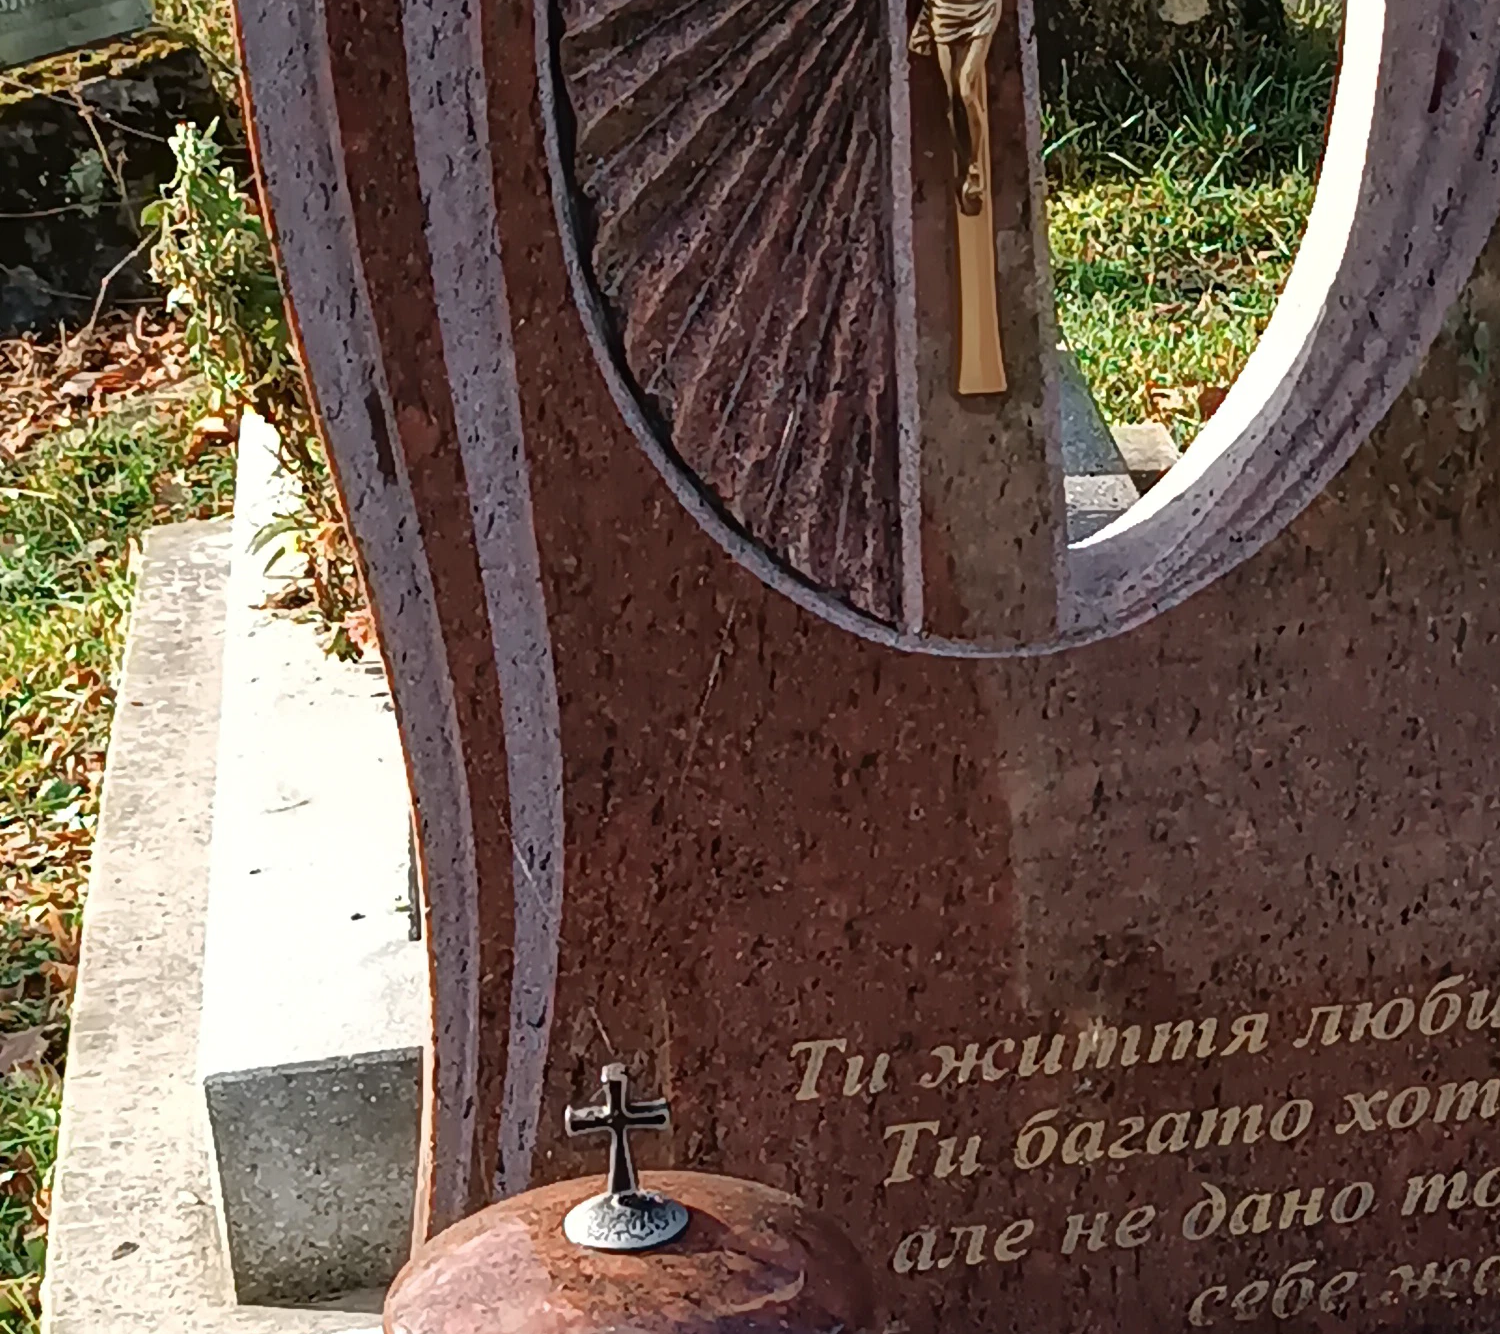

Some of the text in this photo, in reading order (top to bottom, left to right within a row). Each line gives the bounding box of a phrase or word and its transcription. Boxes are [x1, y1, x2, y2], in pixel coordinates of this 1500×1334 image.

[789, 1037, 890, 1101] Ти
[919, 1012, 1269, 1088] життя
[883, 1120, 983, 1187] Ти
[1013, 1098, 1313, 1170] багато
[892, 1218, 1035, 1274] але
[1061, 1204, 1157, 1255] не
[1182, 1179, 1376, 1241] дано
[1188, 1261, 1358, 1327] себе
